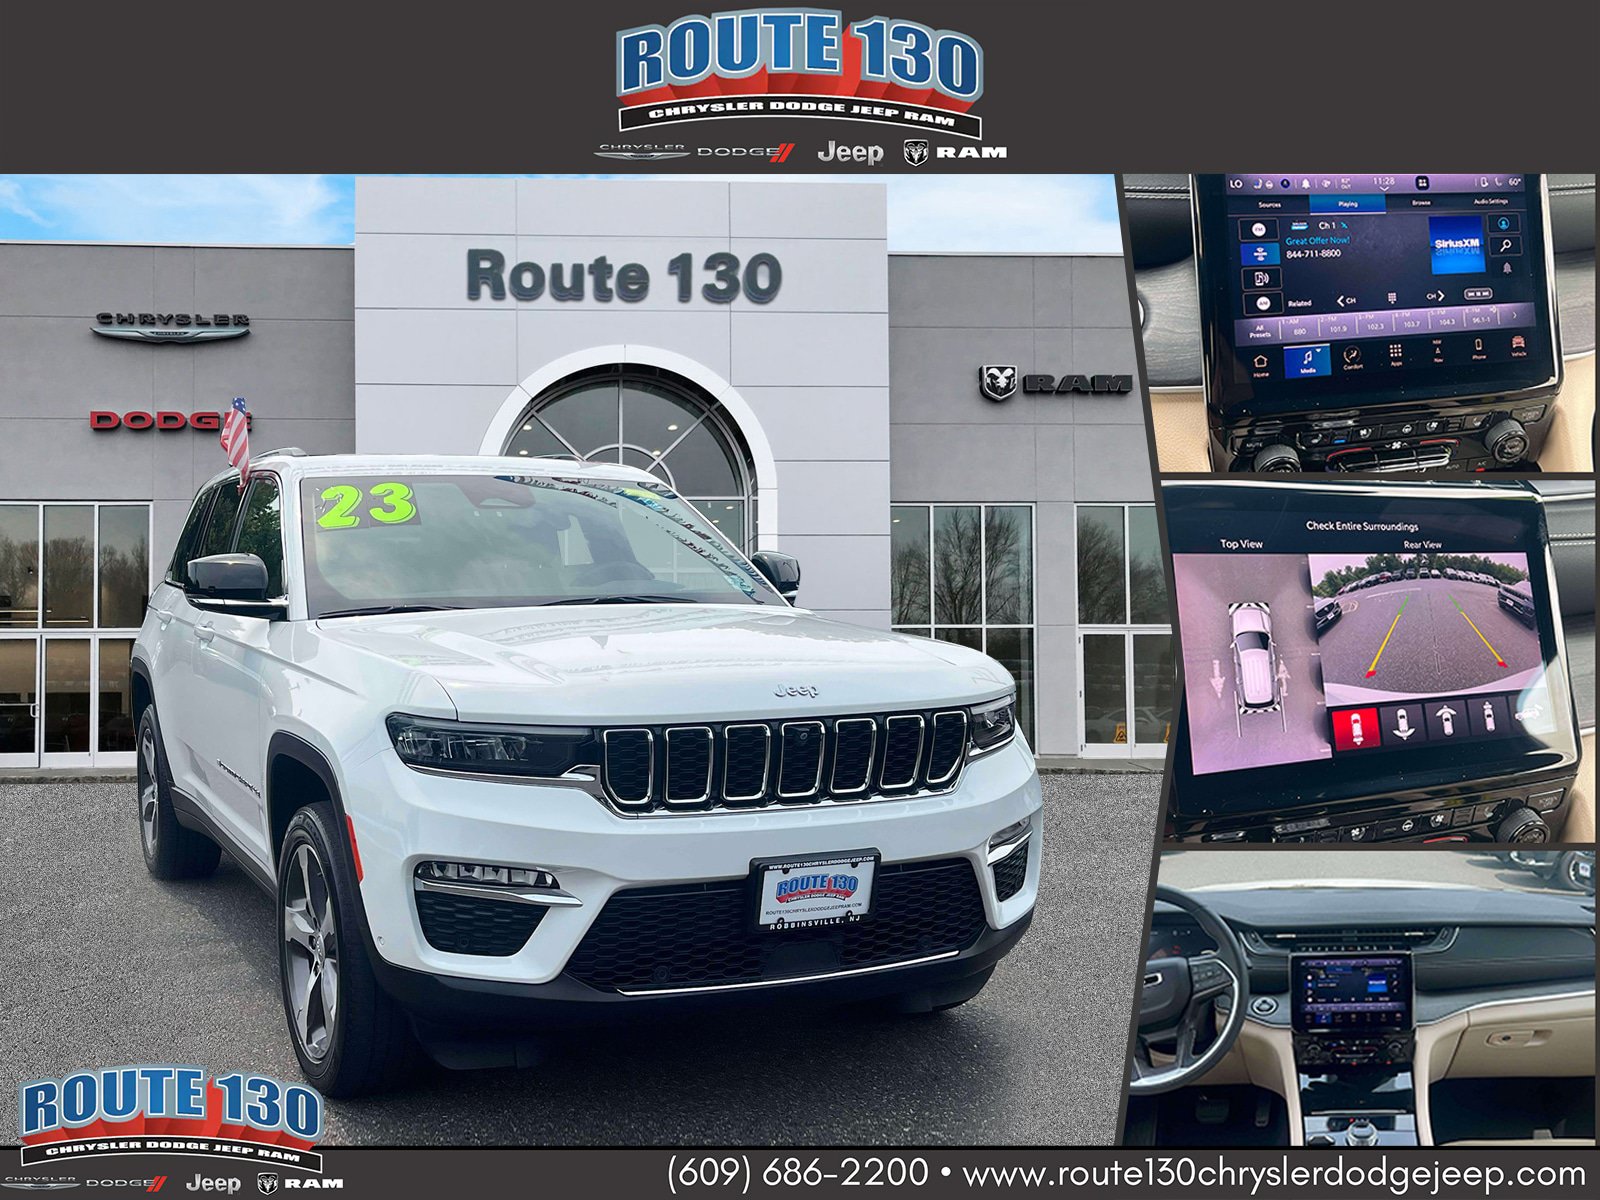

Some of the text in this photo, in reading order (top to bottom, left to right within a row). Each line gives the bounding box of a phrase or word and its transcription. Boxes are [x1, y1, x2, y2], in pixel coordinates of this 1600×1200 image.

[1229, 179, 1244, 189] LO
[1373, 177, 1396, 186] 11:28
[1258, 201, 1282, 209] Sources
[1338, 201, 1359, 209] Playing
[1318, 221, 1331, 230] Ch
[1331, 221, 1336, 229] 1
[1285, 236, 1351, 246] Great Offer Now!
[1434, 238, 1480, 249] SiriusXM
[467, 248, 783, 304] Route 130
[1288, 300, 1312, 308] Related
[96, 312, 250, 326] CHRYSLER
[1403, 320, 1421, 328] 103.7
[1330, 325, 1348, 333] 101.9
[1367, 322, 1384, 330] 102.3
[1022, 375, 1133, 394] RAM
[316, 481, 417, 530] 23
[1306, 520, 1419, 533] Check Entire Surroundings
[1220, 538, 1264, 550] Top View
[1404, 539, 1443, 549] Rear View
[773, 682, 819, 700] Jeep
[777, 873, 859, 897] ROUTE 130
